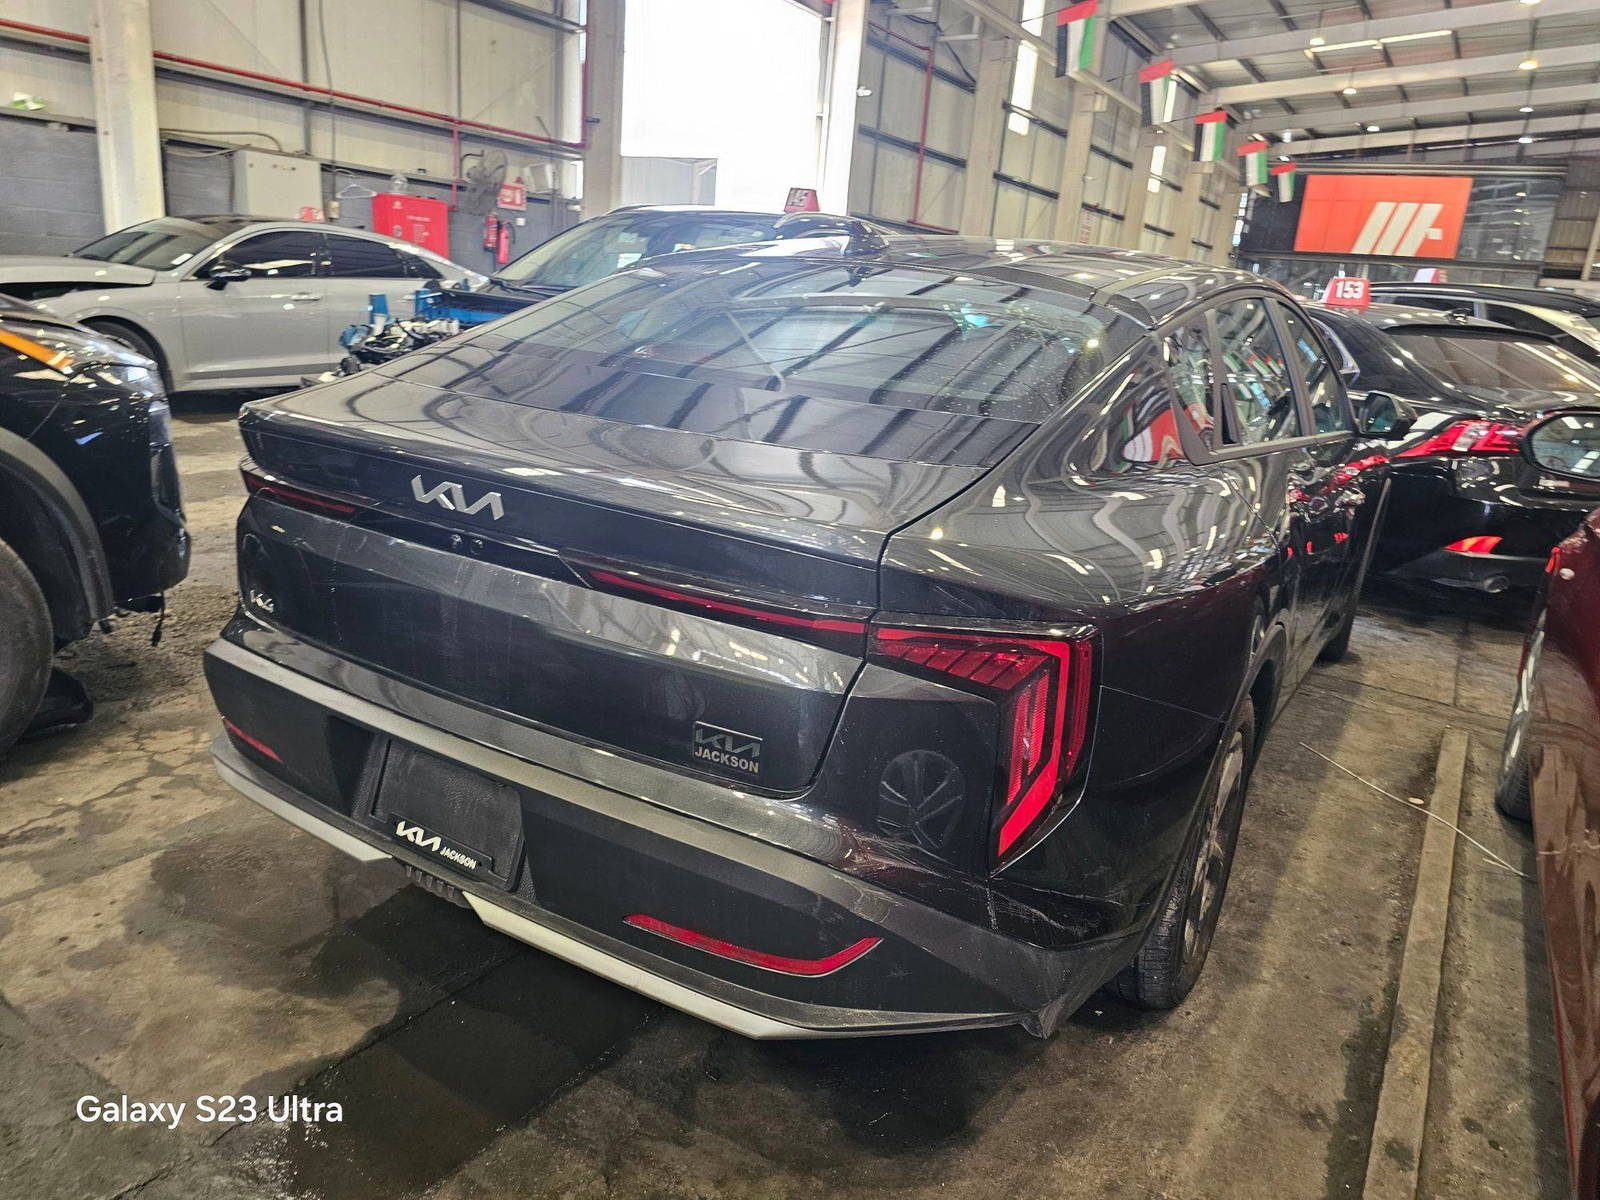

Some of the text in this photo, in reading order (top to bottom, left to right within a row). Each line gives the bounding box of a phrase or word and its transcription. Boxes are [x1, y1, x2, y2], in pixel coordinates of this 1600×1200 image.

[1335, 281, 1364, 299] 153
[411, 474, 505, 521] KIA
[695, 727, 761, 758] KIA
[694, 746, 760, 774] JACKSON
[395, 820, 477, 870] KIA JACKSON
